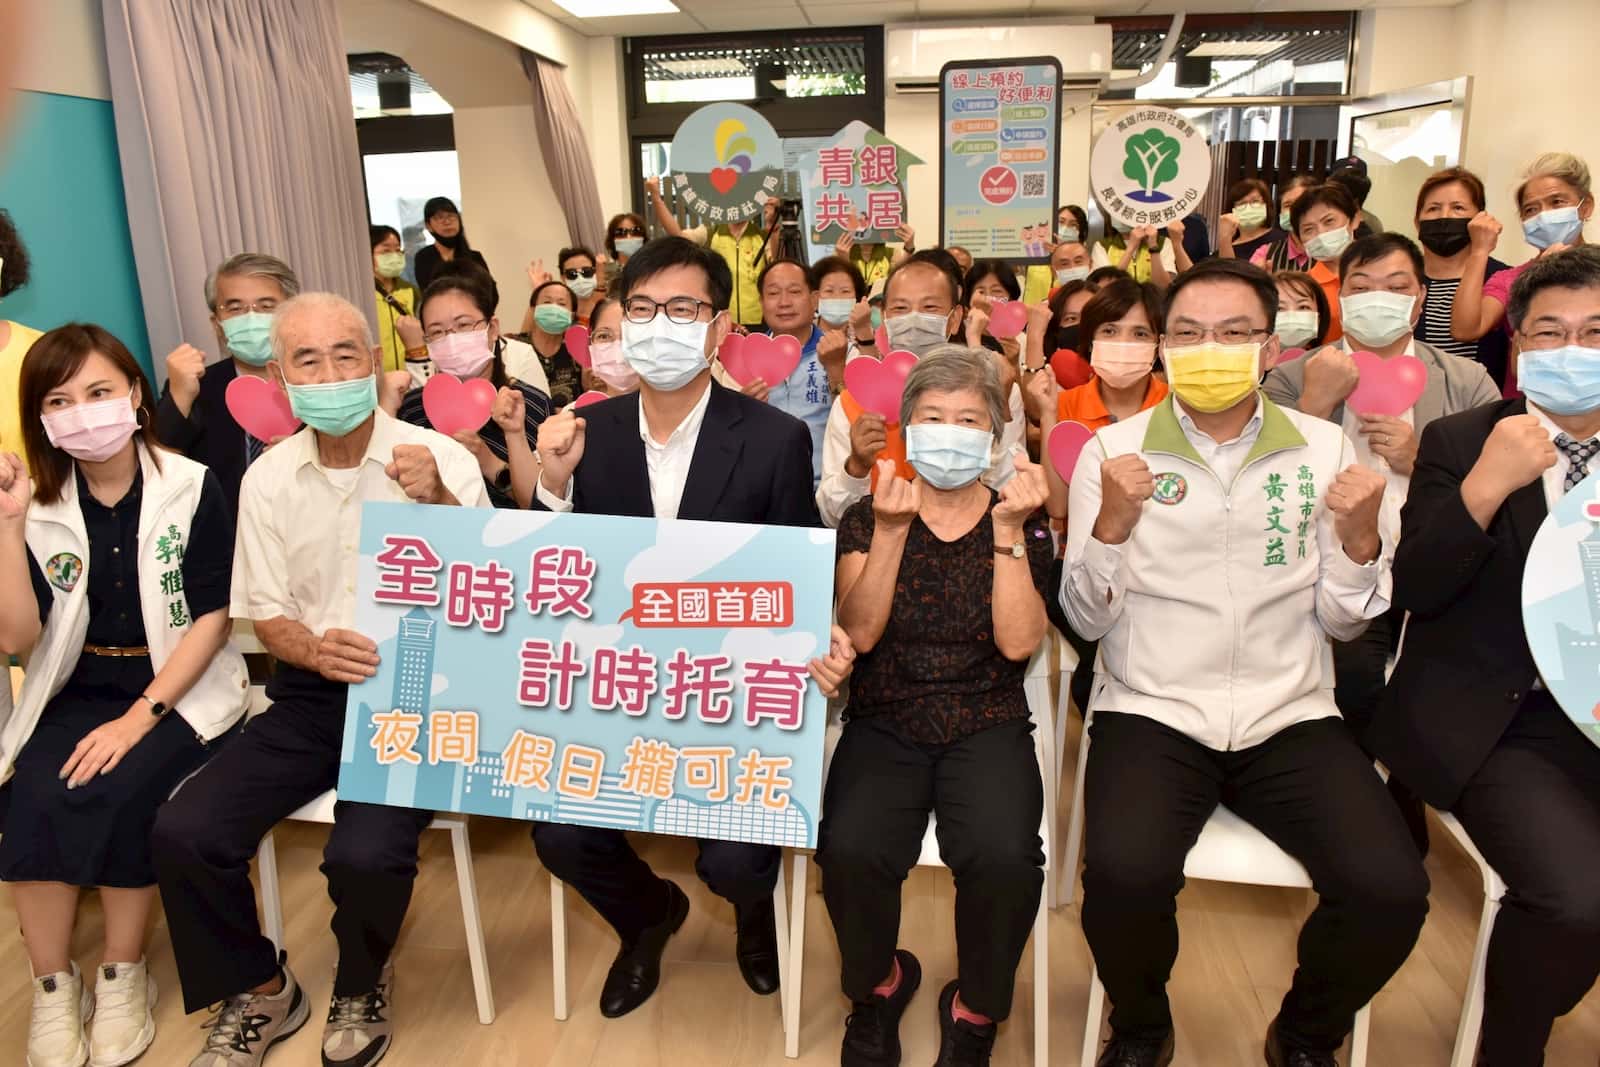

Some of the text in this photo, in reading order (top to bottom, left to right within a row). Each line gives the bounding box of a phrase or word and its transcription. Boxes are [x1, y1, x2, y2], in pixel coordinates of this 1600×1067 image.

[1000, 86, 1054, 104] 好便利
[1116, 110, 1195, 138] 高雄市政府社會局
[819, 146, 898, 187] 青銀
[816, 192, 902, 231] 共居
[1101, 186, 1198, 224] 長青綜合服務中心
[1263, 473, 1291, 567] 黃文益
[156, 536, 187, 628] 李雅慧
[374, 535, 596, 632] 全時段
[638, 587, 785, 625] 全國首創
[519, 640, 809, 729] 計時托育
[371, 711, 793, 809] 夜間 假日 攏可托
